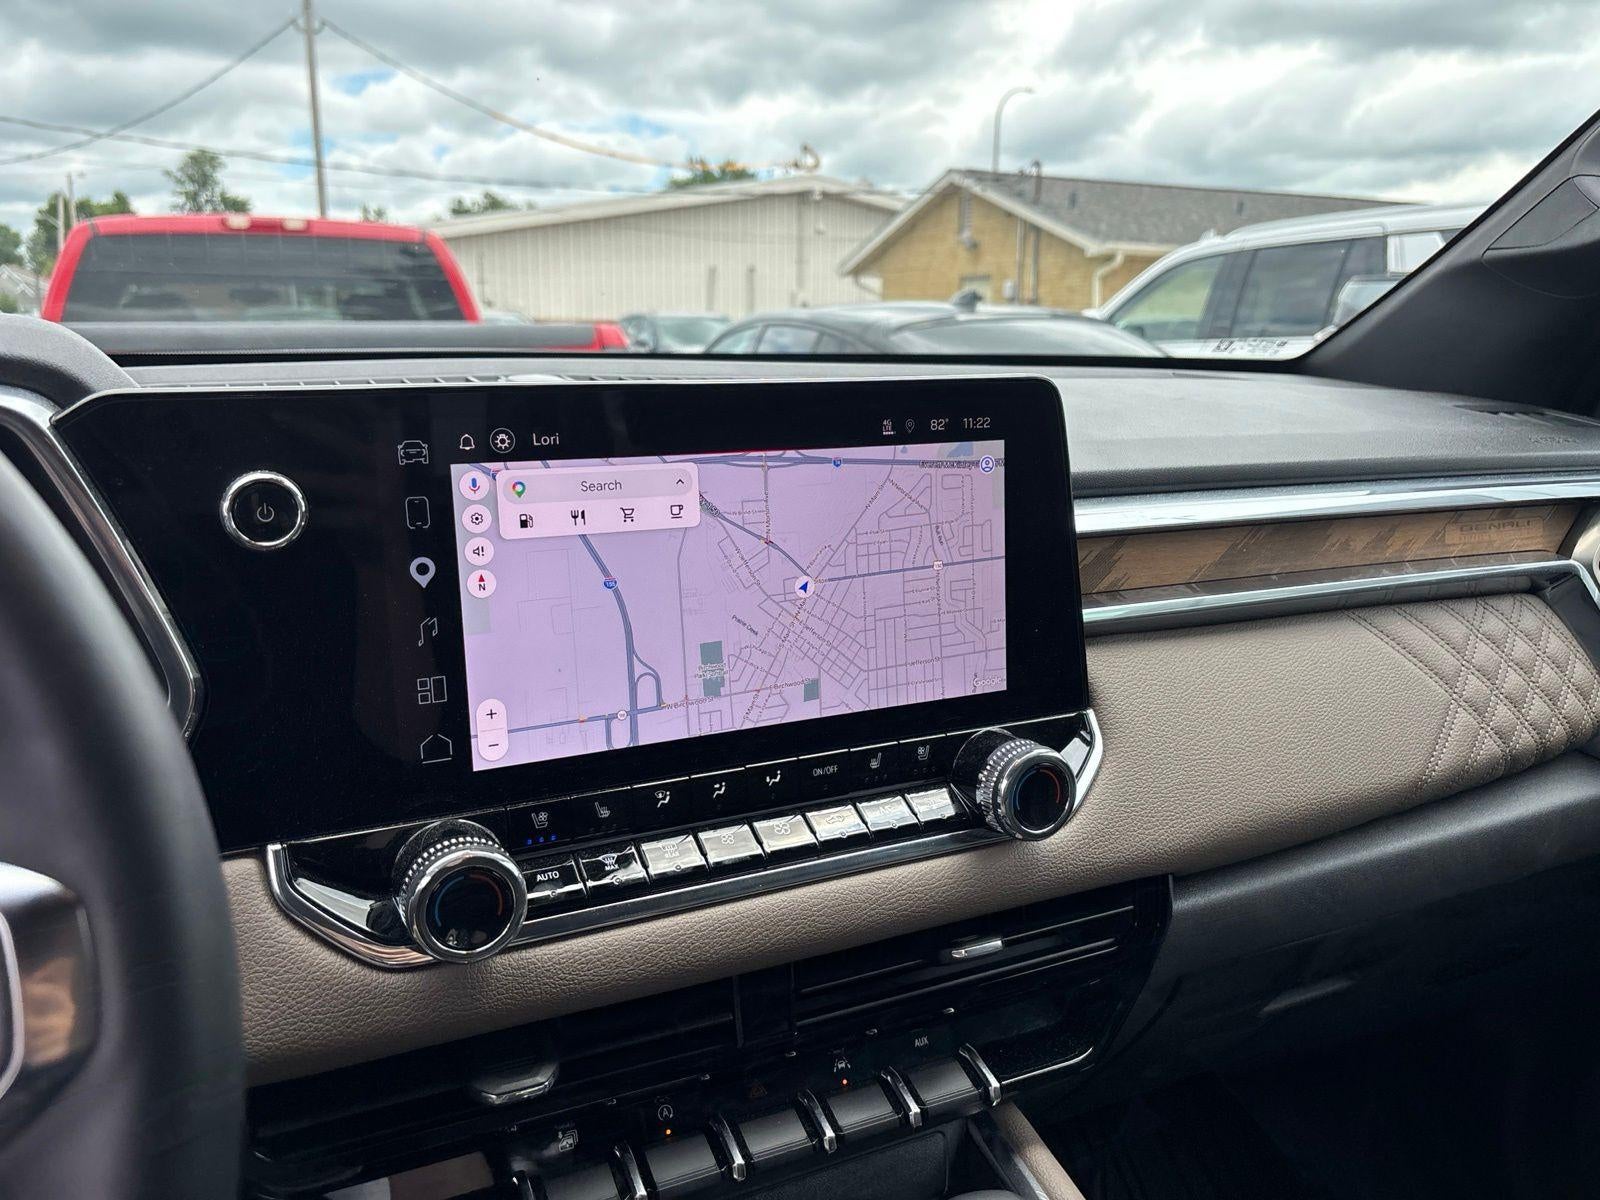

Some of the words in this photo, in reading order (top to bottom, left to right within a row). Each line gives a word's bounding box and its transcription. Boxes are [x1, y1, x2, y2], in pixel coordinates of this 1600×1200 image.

[930, 418, 949, 431] 82°
[963, 417, 991, 429] 11:22
[532, 432, 560, 446] Lori
[580, 479, 622, 492] Search
[1460, 520, 1531, 533] DENALI
[973, 676, 1002, 687] Google
[812, 765, 838, 777] ON/OFF
[604, 863, 620, 871] MAX
[536, 870, 560, 882] AUTO
[914, 1035, 929, 1048] AUX
